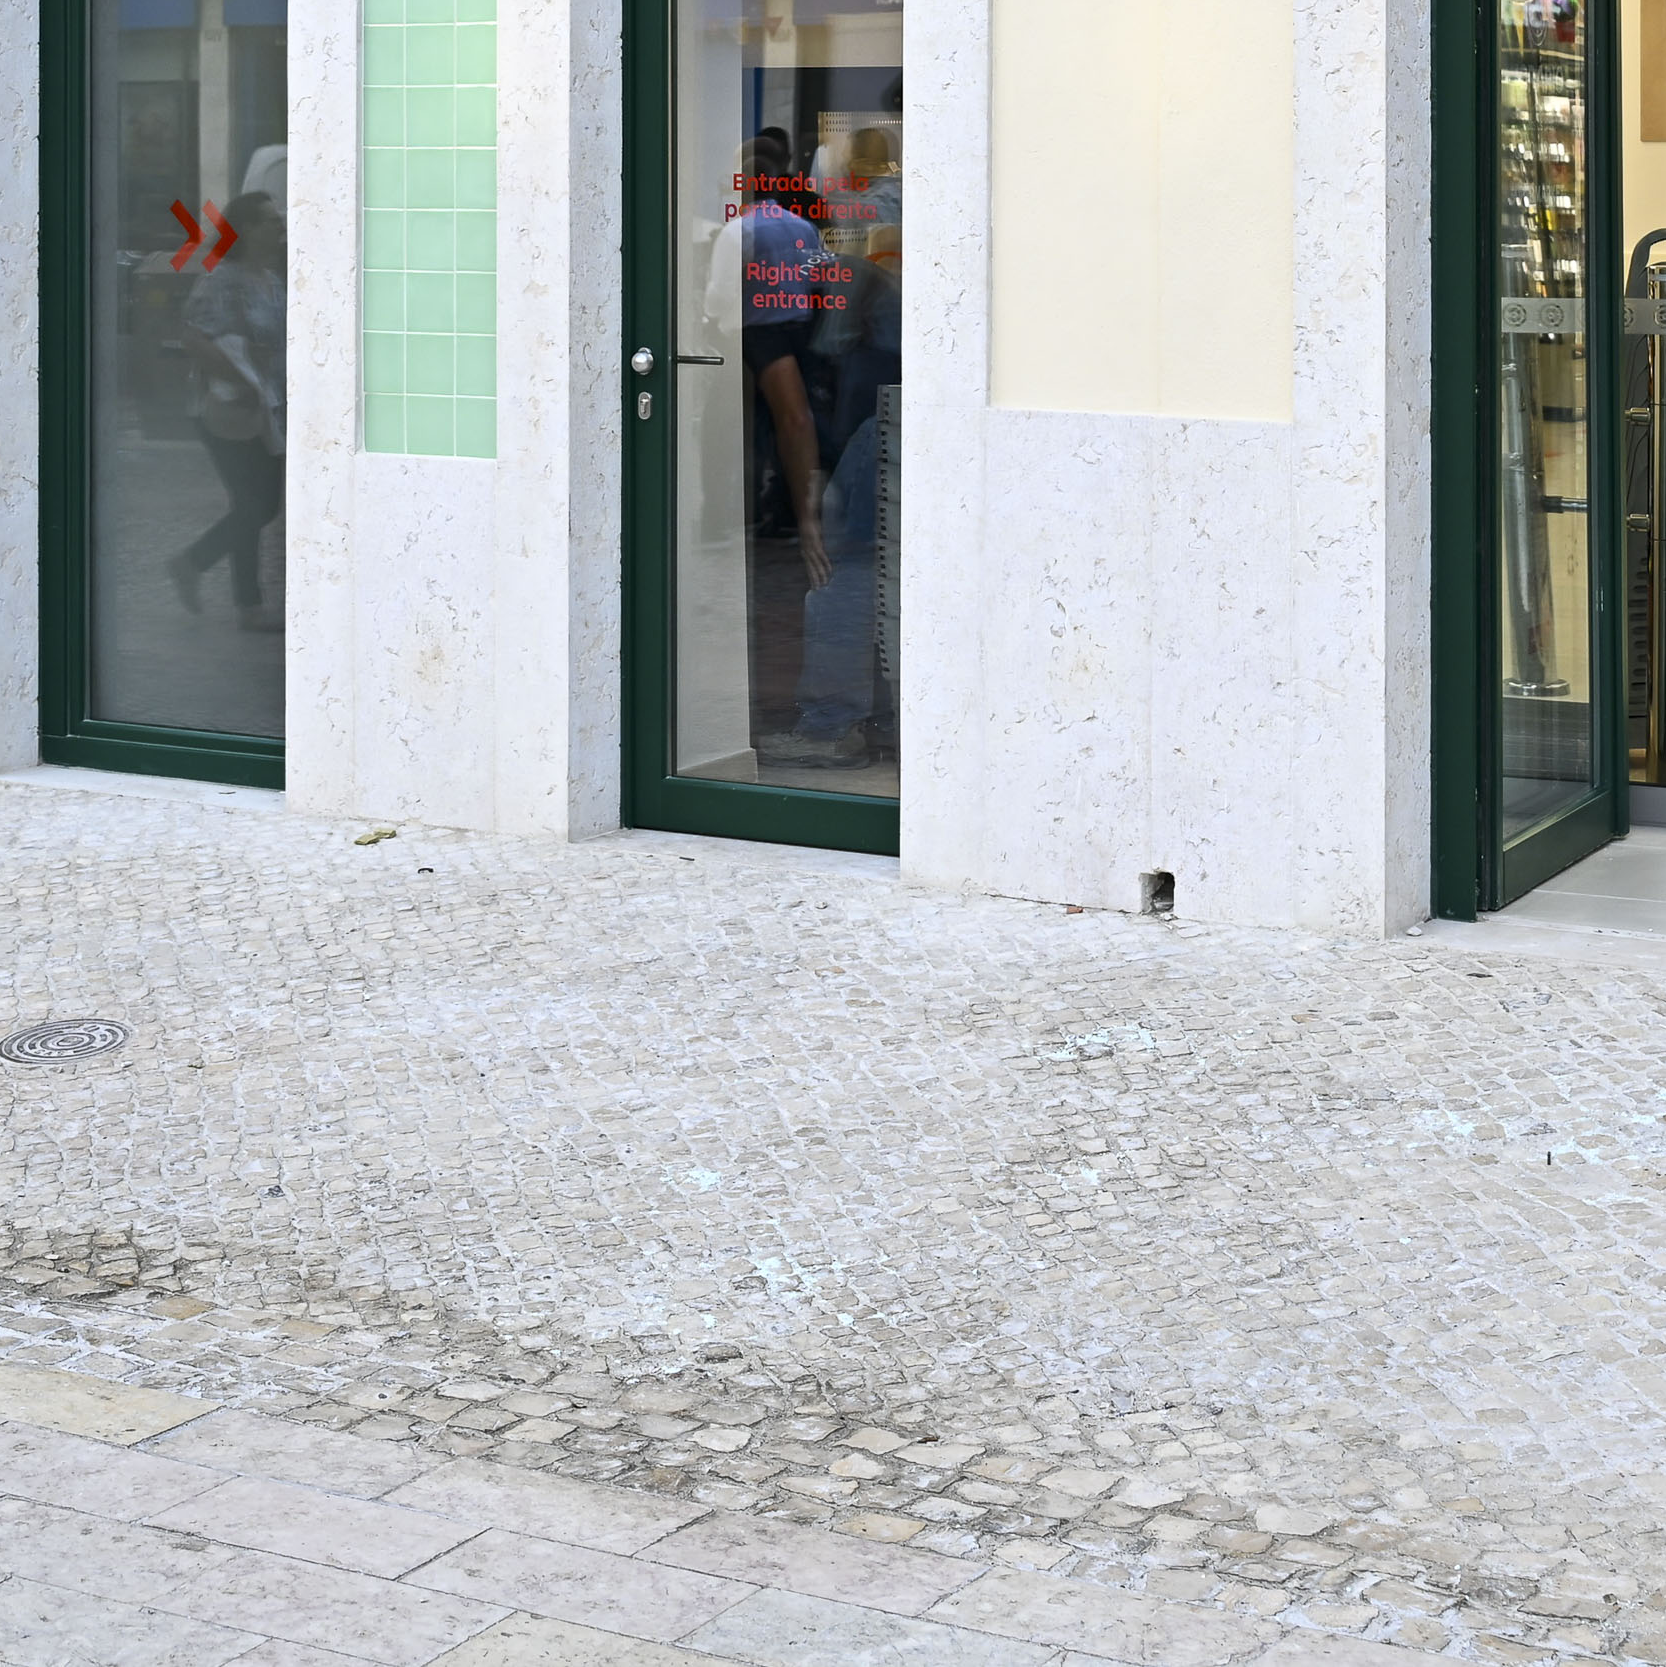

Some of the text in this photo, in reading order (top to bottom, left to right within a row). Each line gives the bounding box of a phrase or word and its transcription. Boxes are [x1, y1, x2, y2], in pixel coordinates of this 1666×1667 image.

[733, 170, 869, 195] Entrada pela
[724, 198, 878, 222] porta à direita
[746, 261, 803, 286] Right
[809, 262, 854, 283] side
[752, 290, 848, 310] entrance
